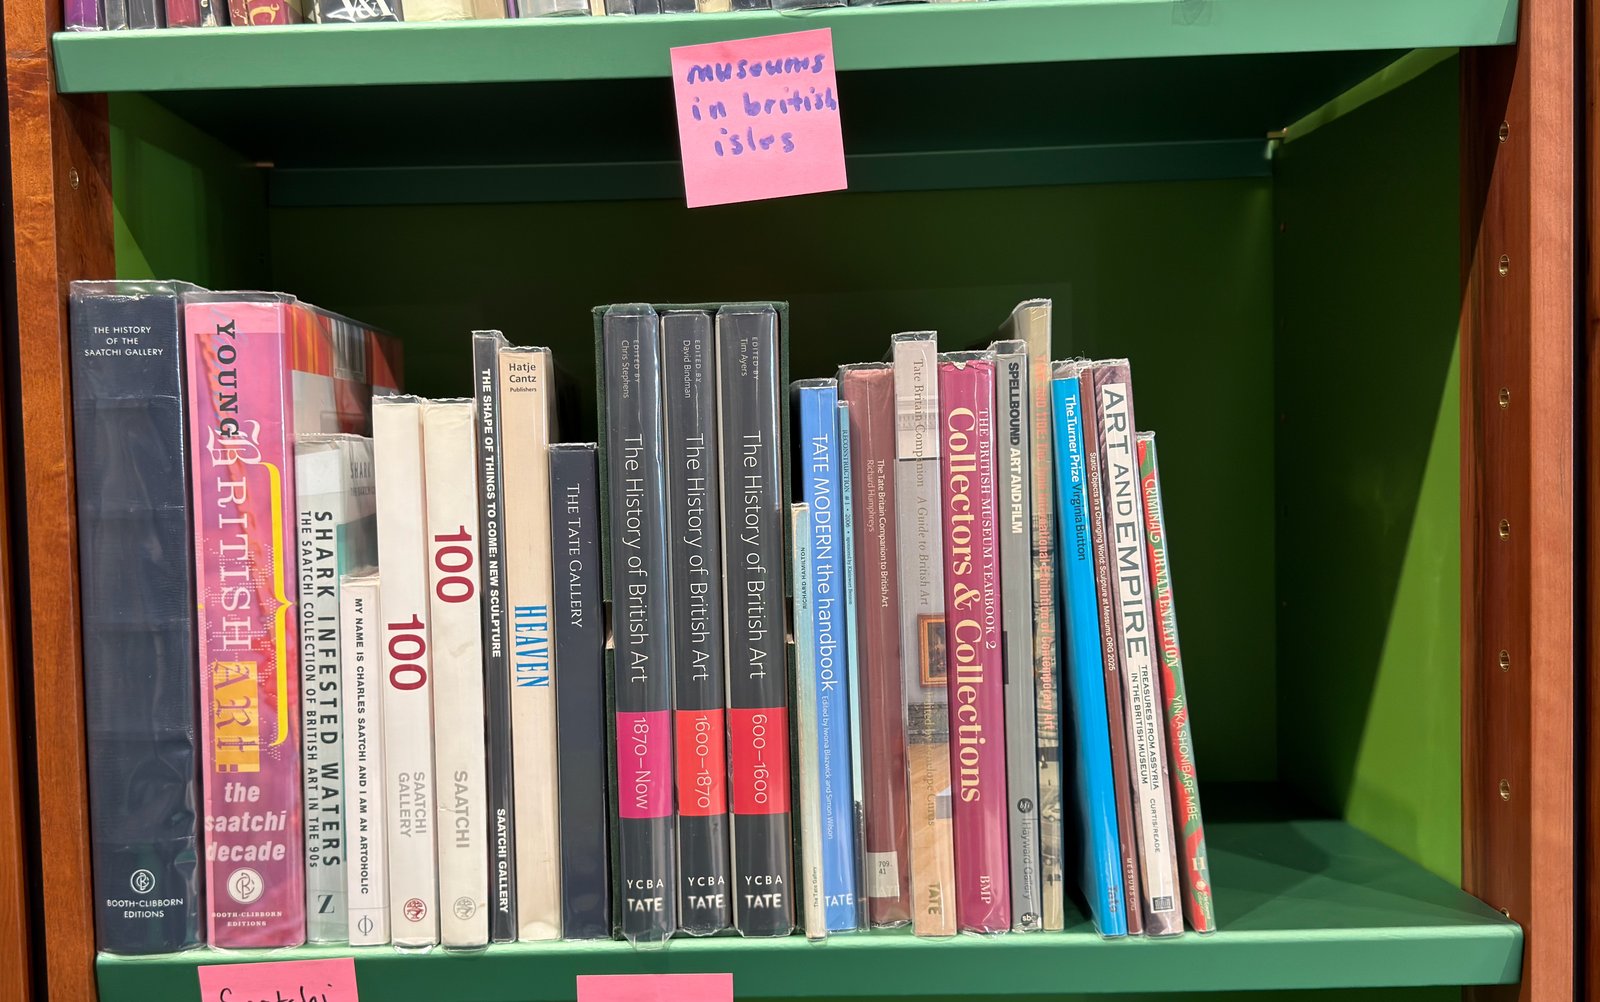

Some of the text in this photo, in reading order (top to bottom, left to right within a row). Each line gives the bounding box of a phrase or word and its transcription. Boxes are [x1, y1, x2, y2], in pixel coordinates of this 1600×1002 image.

[687, 54, 825, 84] museums
[692, 87, 837, 120] in british
[714, 127, 794, 156] isles
[85, 348, 163, 357] SAATCHI GALLERY
[113, 326, 151, 334] HISTORY
[738, 338, 748, 377] Tim Ayers
[217, 319, 239, 438] YOUNG
[509, 362, 537, 373] Hatje
[509, 374, 537, 384] Cantz
[621, 340, 630, 399] Chris Stephens
[683, 340, 691, 399] David Bindman
[812, 433, 829, 472] TATE
[842, 430, 851, 492] RECONSTRUCTION
[1009, 362, 1023, 534] SPELLBOUND ART AND FILM
[867, 459, 875, 532] Richard Humphreys
[913, 359, 930, 606] Tate Britain Companion Guide British Art
[1065, 395, 1087, 561] The Turner Prize Virginia Button
[481, 368, 501, 658] THE SHAPE OF THINGS TO COME: NEW SCULPTURE
[813, 478, 832, 559] MODERN
[878, 474, 887, 563] Tate Companion
[979, 408, 996, 634] THE BRITISH MUSEUM YEARBOOK
[1095, 512, 1103, 543] Changing
[1104, 389, 1148, 658] ART AND EMPIRE
[435, 525, 475, 603] 100
[567, 483, 583, 628] THE TATE GALLERY
[622, 434, 649, 683] The History of British Art
[683, 433, 710, 681] The History of British Art
[740, 430, 768, 679] The History of British Art
[817, 564, 834, 594] the
[1100, 565, 1108, 597] Sculpture
[948, 407, 986, 802] Collectors & Collections
[1103, 605, 1111, 636] Messums
[388, 614, 427, 691] 100
[514, 604, 550, 688] HEAVEN
[818, 599, 838, 691] handbook
[1107, 653, 1115, 671] 2025
[301, 511, 320, 868] THE SAATCHI COLLECTION OF BRITISH ART IN THE 90s
[315, 511, 340, 866] SHARK INFESTED WATERS
[1040, 637, 1055, 730] Contemporary Art
[1173, 694, 1185, 729] YINKA
[355, 598, 369, 895] MY NAME CHARLES SAATCHI AND AM AN ARTOHOLIC
[1131, 672, 1148, 784] IN THE BRITISH MUSEUM
[1141, 664, 1159, 790] TREASURES FROM ASSYRIA
[1177, 730, 1195, 794] SHONIBARE
[204, 810, 287, 832] saatchi
[224, 782, 261, 803] the
[399, 772, 412, 838] GALLERY
[414, 772, 427, 834] SAATCHI
[454, 770, 470, 848] SAATCHI
[1186, 796, 1198, 821] MBE
[206, 841, 287, 862] decade
[1150, 798, 1160, 853] CURTIS/READE
[497, 808, 508, 913] SAATCHI GALLERY
[627, 878, 664, 889] YCBA
[688, 875, 725, 887] YCBA
[745, 873, 783, 886] YCBA
[979, 875, 991, 904] BMP
[124, 910, 165, 918] EDITIONS
[318, 894, 335, 914] Z
[627, 896, 663, 912] TATE
[688, 893, 725, 909] TATE
[745, 893, 782, 909] TATE
[824, 893, 854, 907] TATE
[928, 883, 942, 916] TATE
